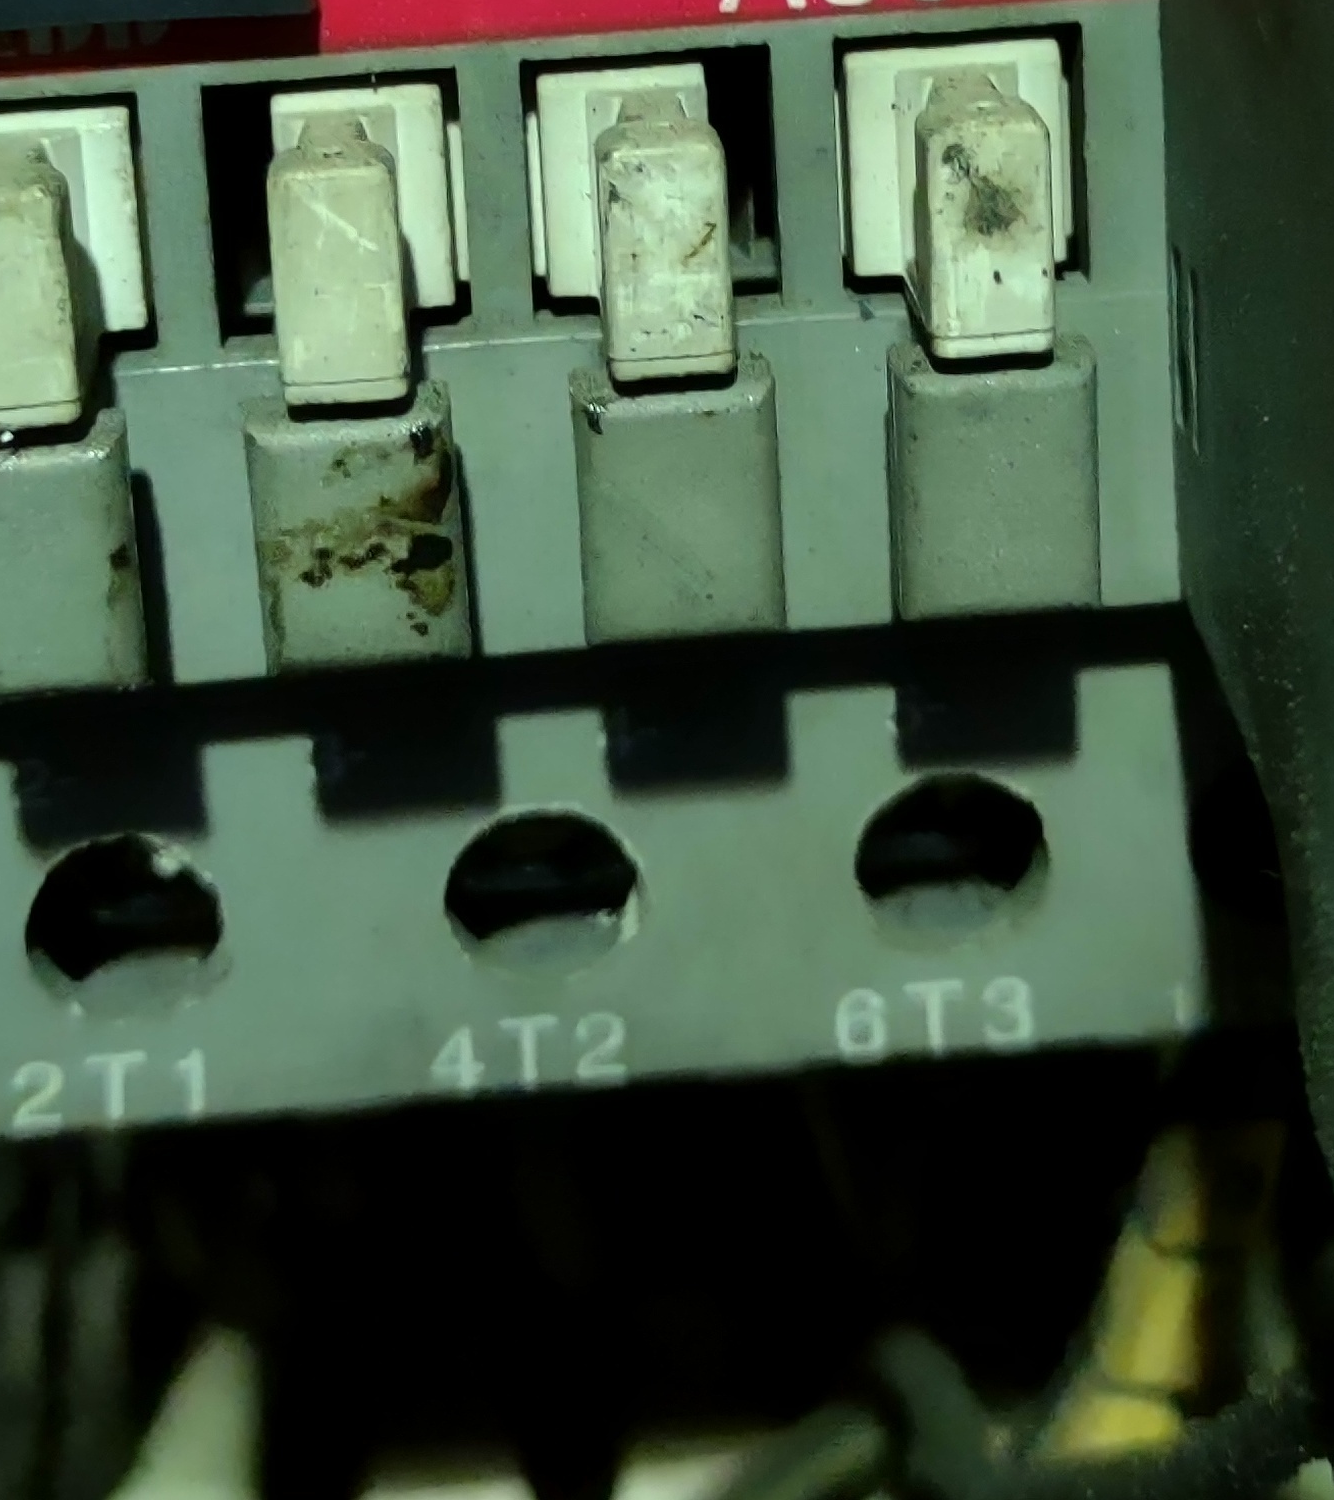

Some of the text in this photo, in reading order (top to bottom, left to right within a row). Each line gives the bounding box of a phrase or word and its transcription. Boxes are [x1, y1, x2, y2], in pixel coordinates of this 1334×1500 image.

[431, 1012, 628, 1088] 4T2
[833, 976, 1035, 1056] 6T3
[10, 1048, 207, 1129] 2T1
